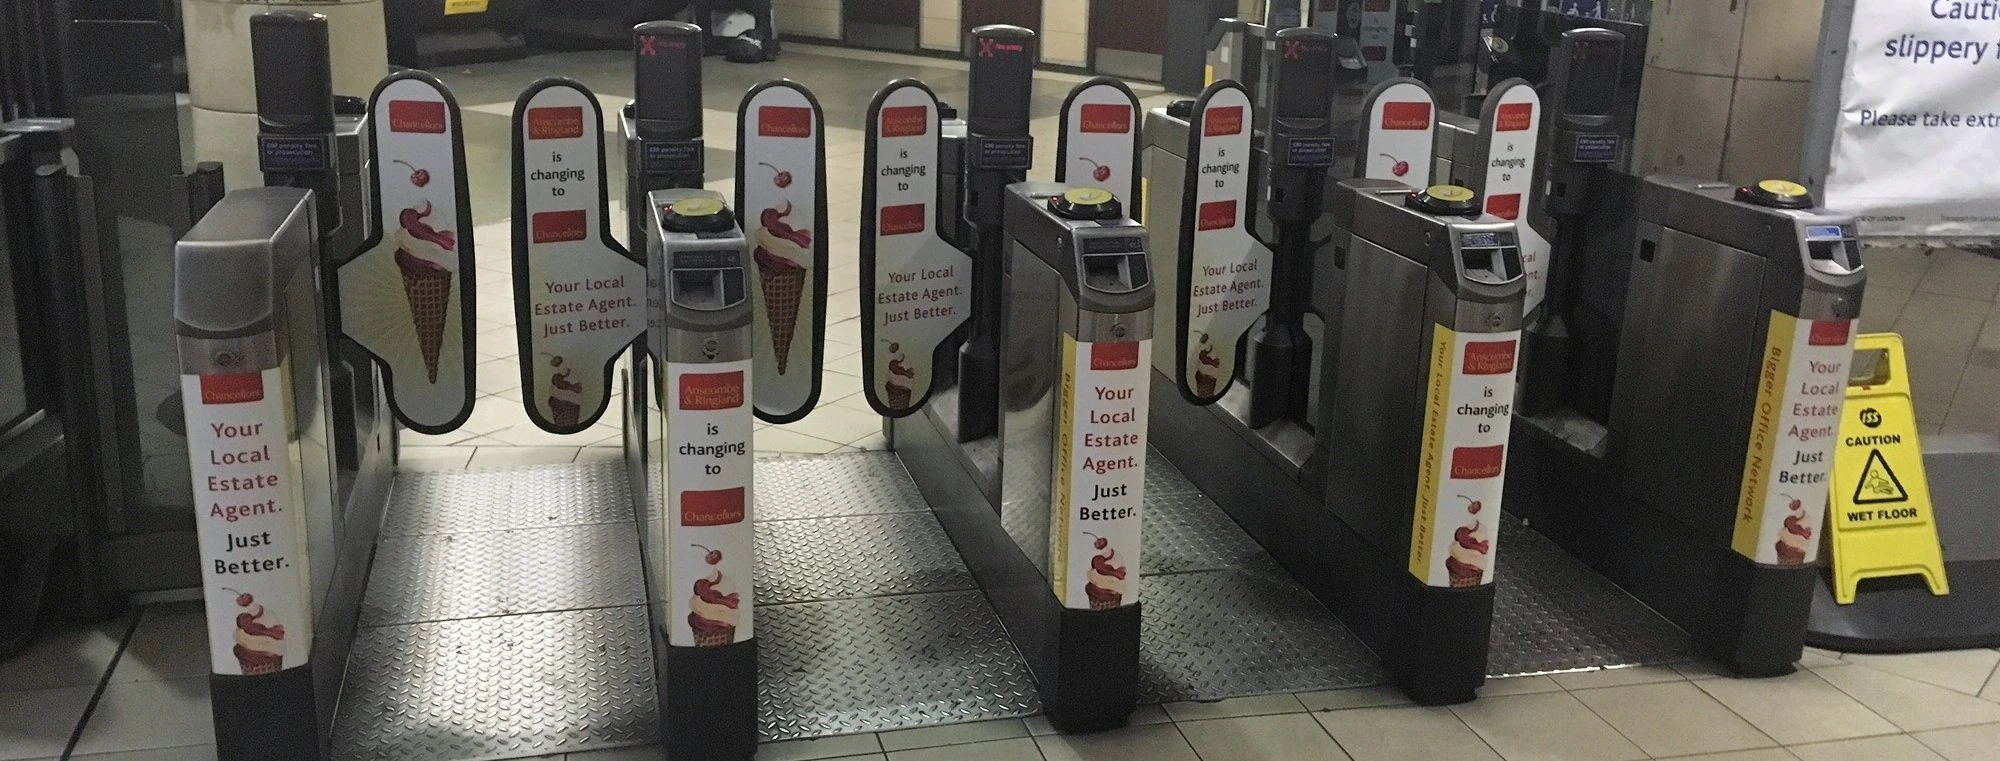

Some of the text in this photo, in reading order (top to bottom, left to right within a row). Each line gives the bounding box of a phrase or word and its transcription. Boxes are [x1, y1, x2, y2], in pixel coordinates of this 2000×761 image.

[1931, 0, 2000, 20] Cauti
[1884, 34, 1989, 65] slippery
[1860, 109, 2000, 128] Please take extr
[900, 148, 908, 158] is
[1218, 148, 1225, 157] is
[1507, 142, 1514, 151] is
[552, 151, 562, 162] is
[1491, 157, 1526, 169] changing
[530, 167, 586, 182] changing
[881, 163, 926, 177] changing
[1201, 163, 1240, 175] changing
[1215, 180, 1225, 188] to
[1502, 173, 1511, 182] to
[552, 185, 565, 197] to
[898, 182, 909, 191] to
[888, 266, 954, 283] Your Local
[1202, 259, 1258, 277] Your Local
[545, 275, 625, 294] Your Local
[1193, 279, 1264, 297] Estate Agent.
[878, 286, 963, 304] Estate Agent.
[535, 296, 637, 316] Estate Agent.
[1197, 299, 1257, 317] Just Better.
[884, 306, 957, 326] Just Better.
[543, 317, 630, 338] Just Better.
[1438, 341, 1447, 367] Your
[1808, 361, 1841, 374] Your
[1095, 386, 1135, 401] Your
[1433, 372, 1443, 407] Local
[1483, 386, 1493, 397] is
[1801, 381, 1839, 395] Local
[1090, 408, 1136, 424] Local
[1457, 403, 1509, 418] changing
[1792, 403, 1838, 417] Estate
[211, 422, 263, 438] Your
[707, 423, 718, 435] is
[1478, 423, 1491, 434] to
[1742, 346, 1782, 521] Bigger Office Network
[1084, 432, 1138, 447] Estate
[1845, 434, 1901, 447] CAUTION
[210, 446, 271, 465] Local
[679, 440, 745, 458] changing
[1082, 456, 1138, 475] Agent.
[1793, 450, 1823, 466] Just
[705, 463, 722, 475] to
[208, 472, 278, 492] Estate
[1092, 483, 1127, 501] Just
[210, 499, 283, 522] Agent.
[1079, 505, 1137, 522] Better.
[1847, 508, 1917, 522] WET FLOOR
[226, 531, 272, 552] Just
[214, 555, 290, 575] Better.
